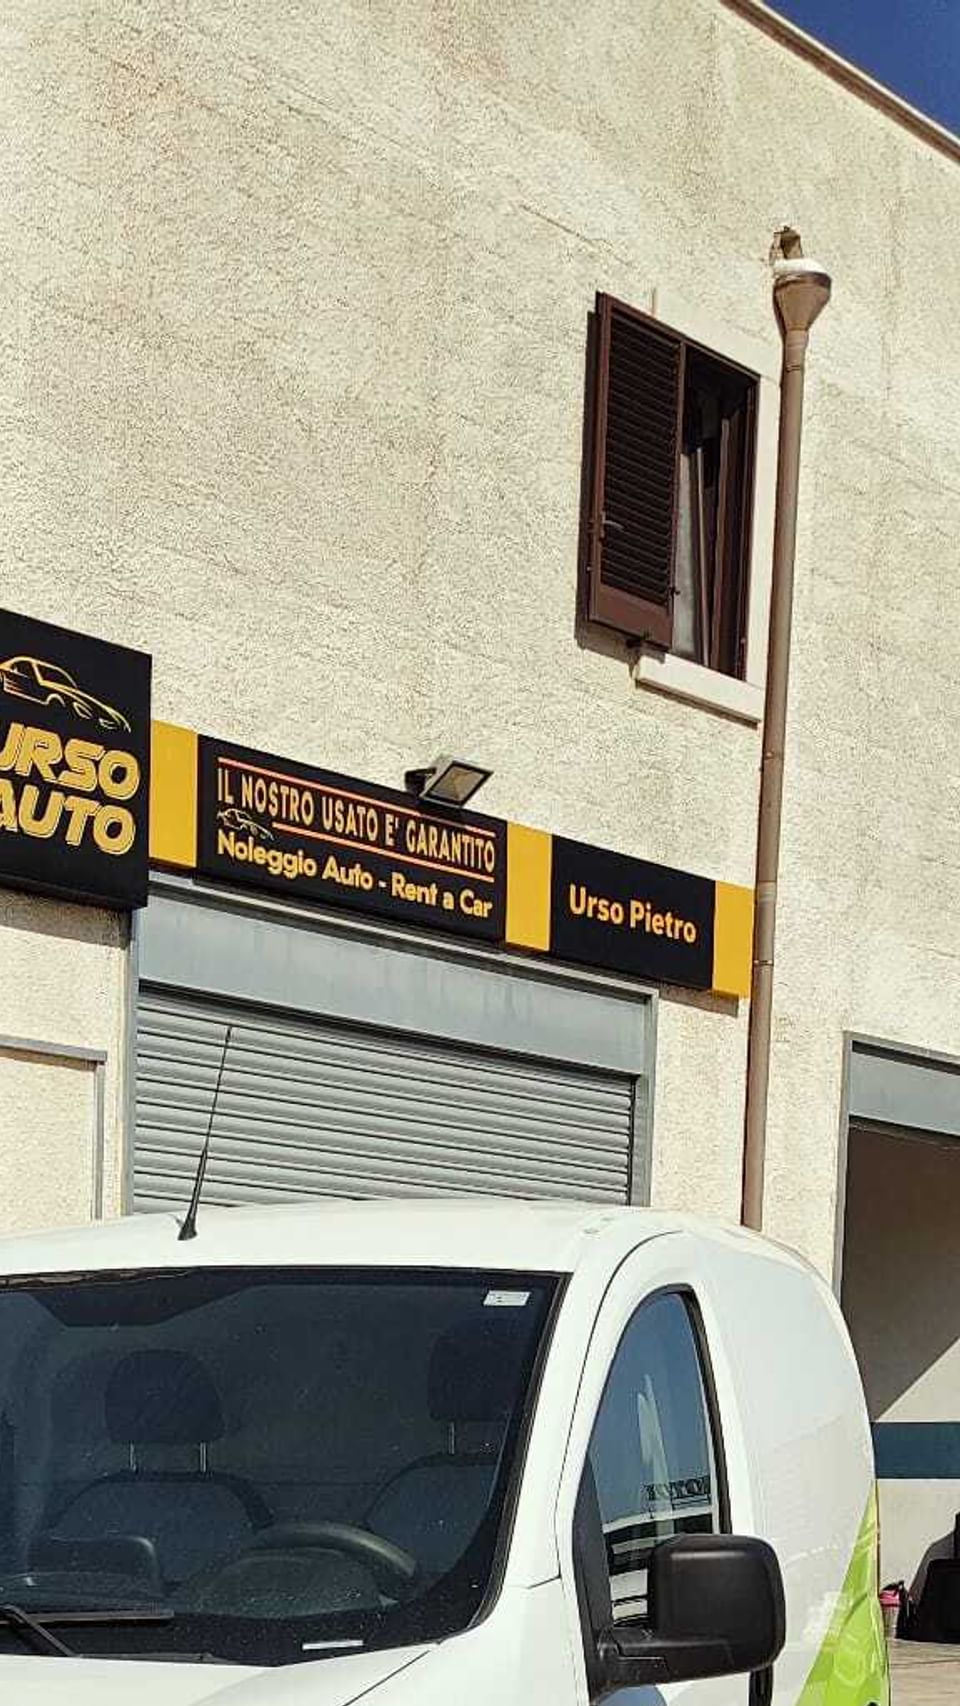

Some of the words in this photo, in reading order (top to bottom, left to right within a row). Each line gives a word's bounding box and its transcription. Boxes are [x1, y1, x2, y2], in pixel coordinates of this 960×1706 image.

[218, 768, 233, 805] IL
[242, 774, 313, 826] NOSTRO
[322, 796, 379, 842] USATO
[406, 822, 495, 873] GARANTITO
[217, 829, 317, 879] Noleggio
[323, 856, 373, 890] Auto
[391, 870, 438, 906] Rent
[442, 893, 454, 910] a
[460, 889, 492, 918] Car
[569, 883, 624, 925] Urso
[630, 900, 696, 943] Pietro
